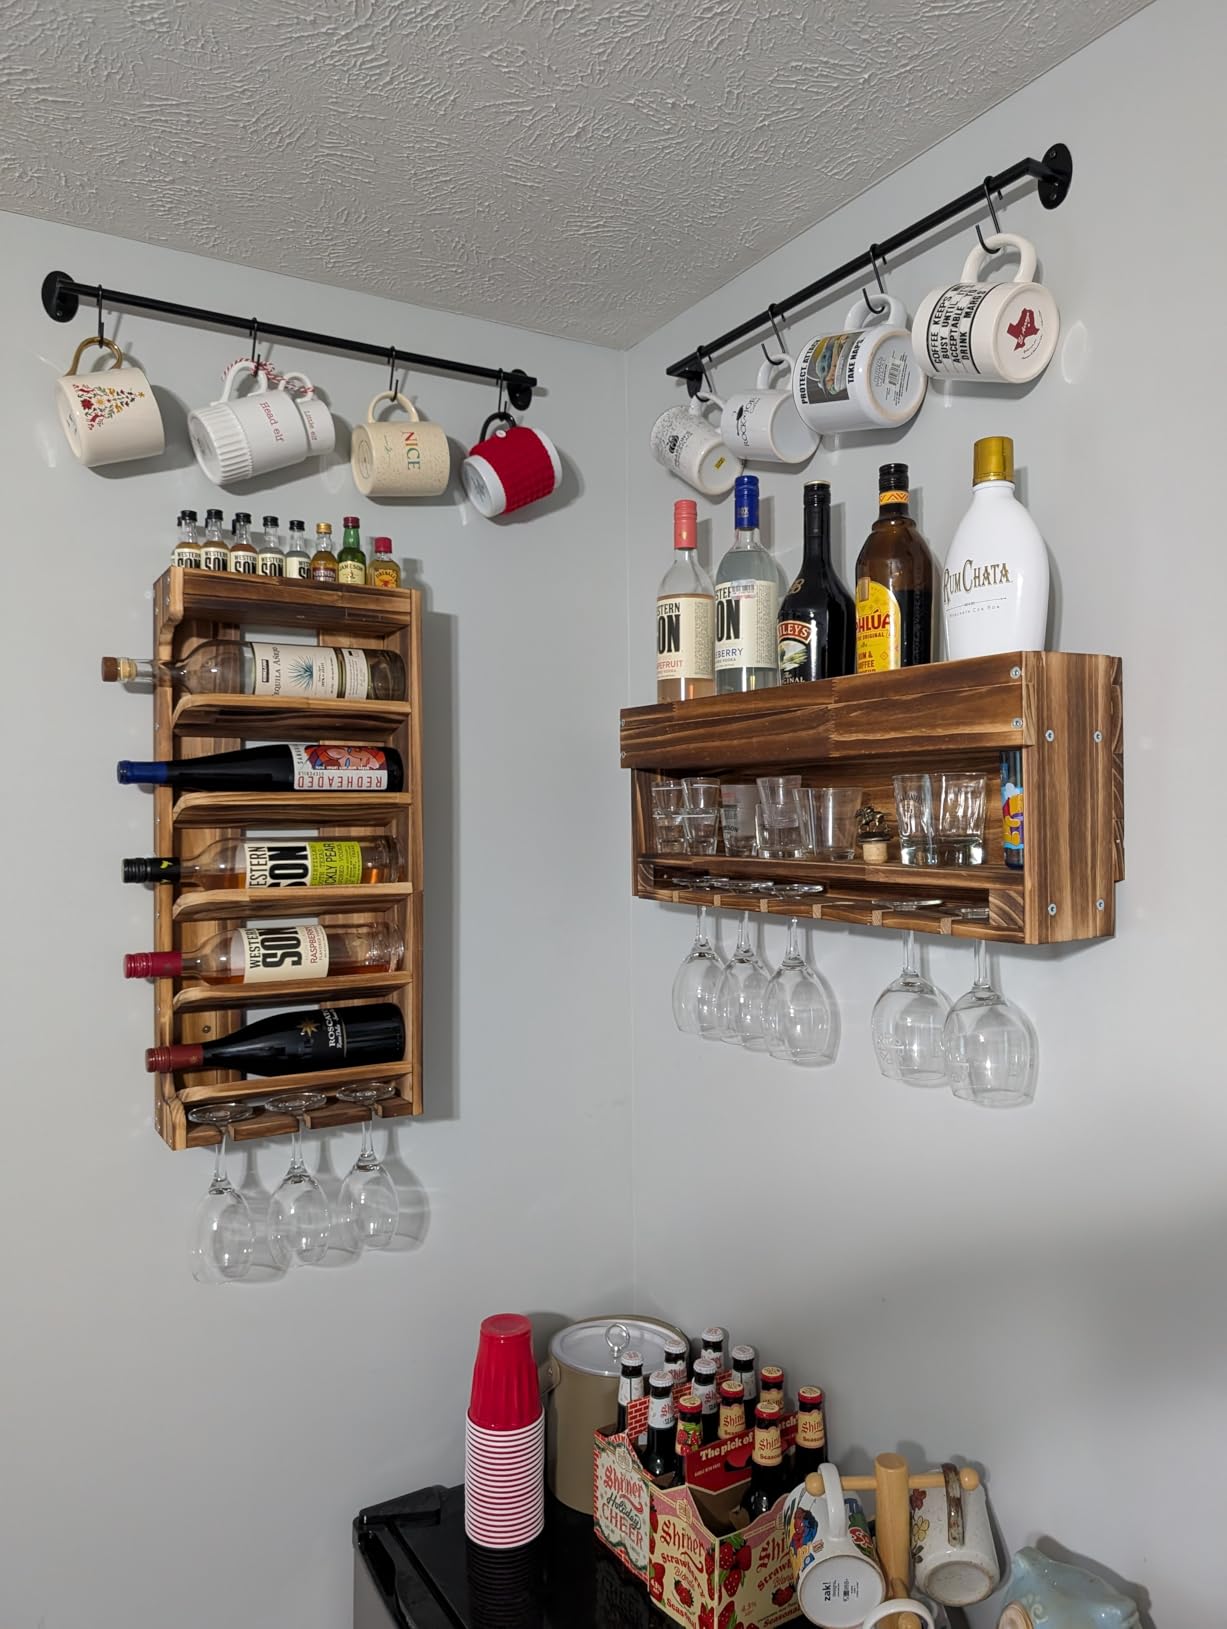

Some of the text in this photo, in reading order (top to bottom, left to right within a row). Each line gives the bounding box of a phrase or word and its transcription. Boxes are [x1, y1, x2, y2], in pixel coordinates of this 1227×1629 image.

[933, 296, 952, 326] KEEPS
[942, 300, 959, 328] UNTIL
[931, 331, 942, 364] COFFEE
[940, 336, 950, 359] BUSY
[949, 306, 965, 364] ACCEPTABLE
[960, 331, 970, 360] DRINK
[847, 362, 856, 384] TAKE
[259, 402, 284, 442] Head elf
[401, 431, 421, 470] NICE
[298, 776, 382, 788] REDHEADED
[248, 846, 267, 887] ESTERN
[323, 842, 337, 863] PEAR
[245, 929, 261, 969] WESTERN
[258, 926, 302, 969] SON
[700, 1447, 720, 1460] The
[721, 1437, 742, 1456] pick
[742, 1432, 754, 1445] of
[604, 1465, 645, 1498] Shiner
[602, 1502, 643, 1550] CHEER
[607, 1492, 641, 1530] Holiday
[660, 1520, 705, 1558] Shiner
